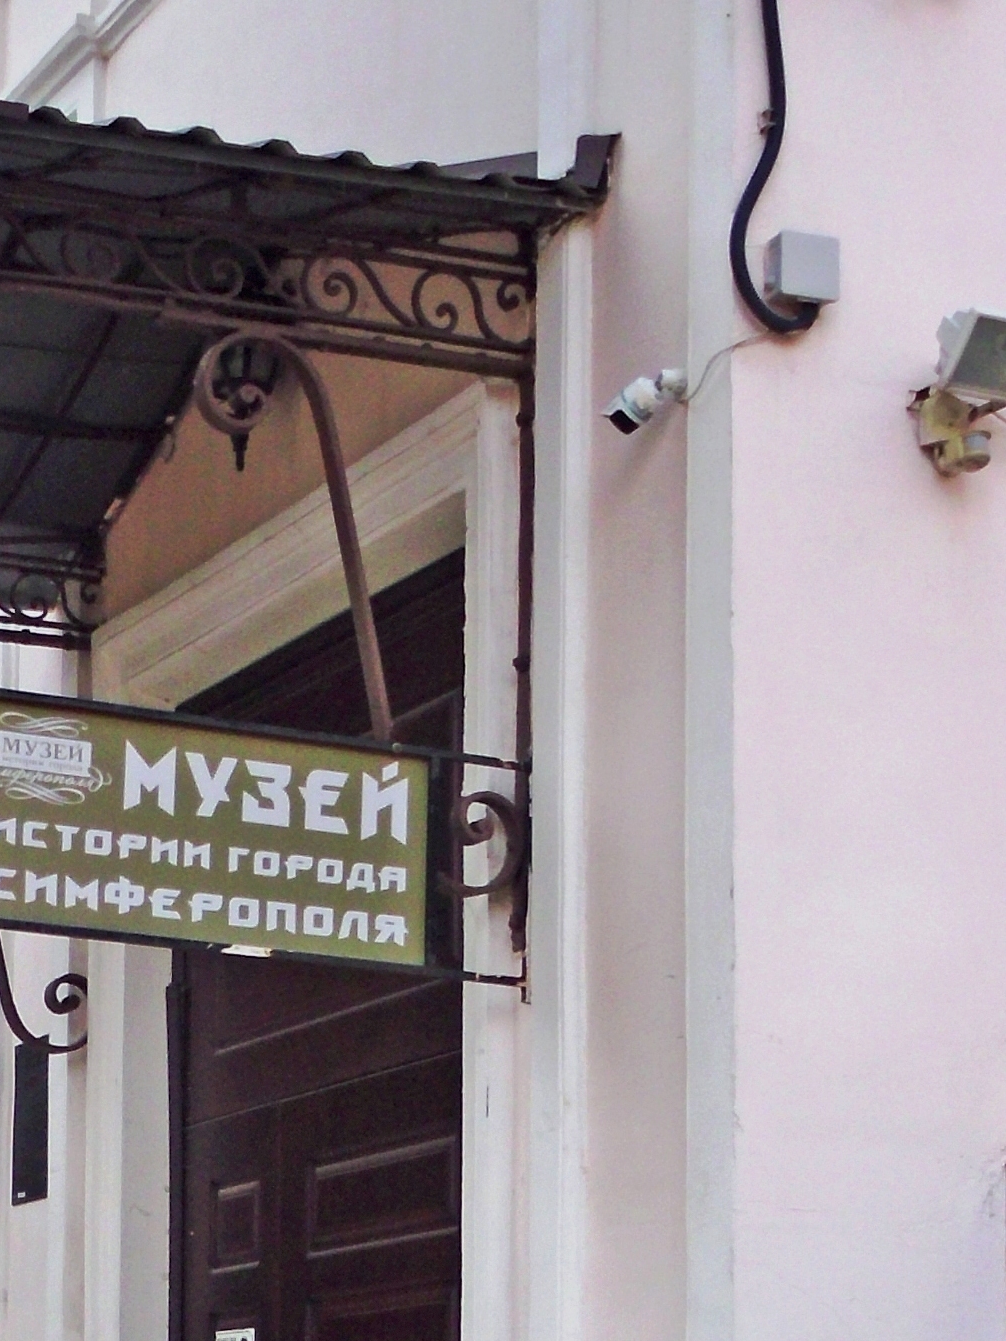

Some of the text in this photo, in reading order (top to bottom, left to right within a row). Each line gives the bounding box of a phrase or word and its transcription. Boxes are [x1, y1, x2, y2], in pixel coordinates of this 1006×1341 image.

[1, 736, 84, 764] МУЗЕЙ
[123, 739, 408, 845] МУЗЕЙ
[228, 847, 407, 893] ГОРОДА
